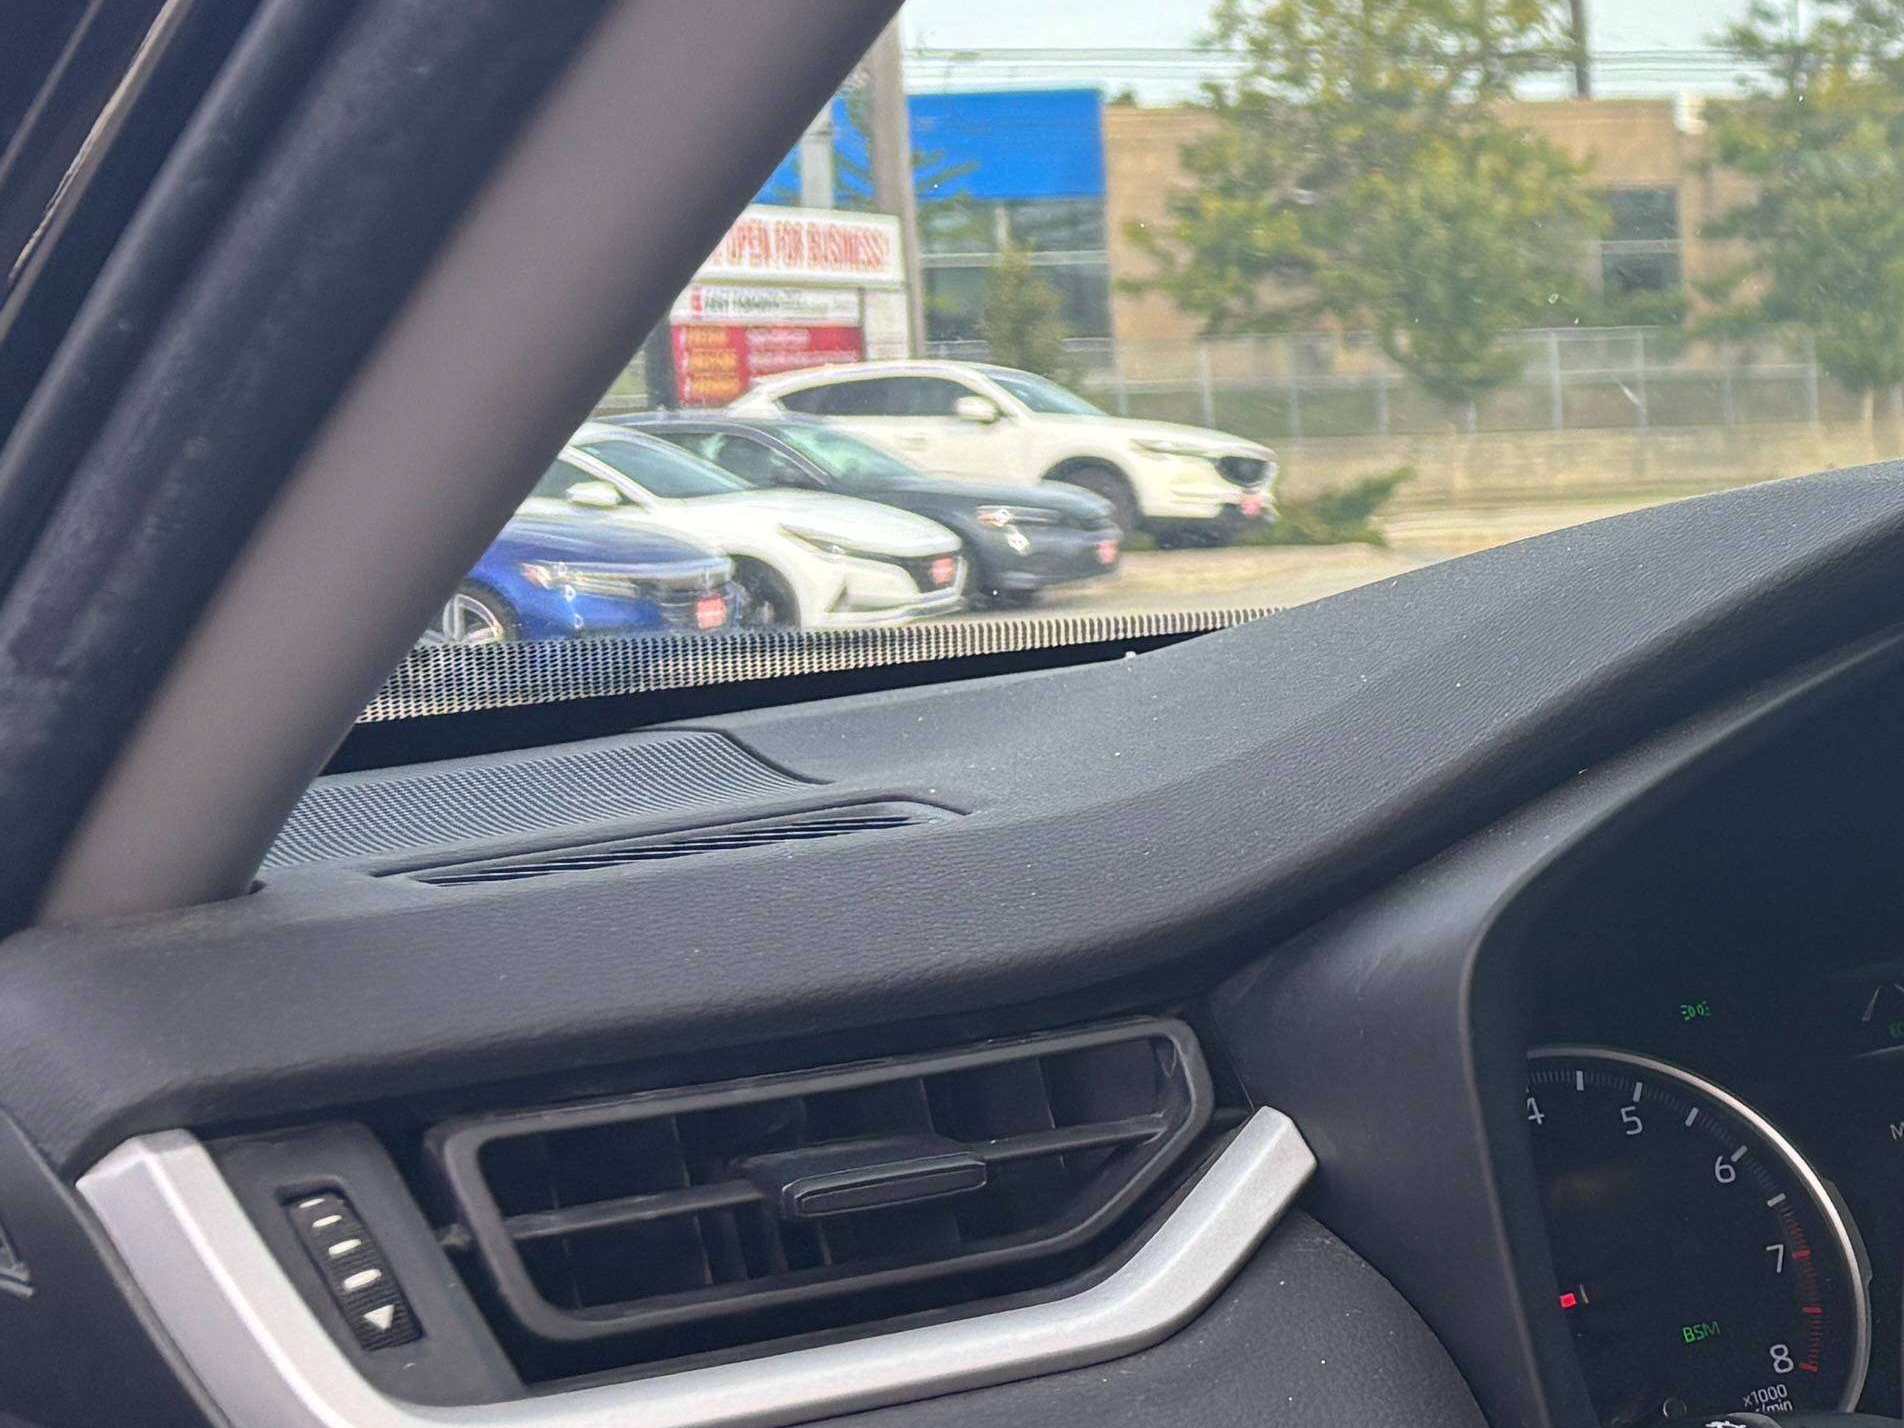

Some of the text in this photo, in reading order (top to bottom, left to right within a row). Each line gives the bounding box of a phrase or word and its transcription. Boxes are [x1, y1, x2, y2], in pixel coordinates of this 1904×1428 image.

[1526, 1096, 1546, 1125] 4
[1620, 1106, 1645, 1136] 5
[1713, 1155, 1737, 1184] 6
[1765, 1243, 1785, 1274] 7
[1680, 1320, 1722, 1345] BSM
[1769, 1343, 1795, 1374] 8
